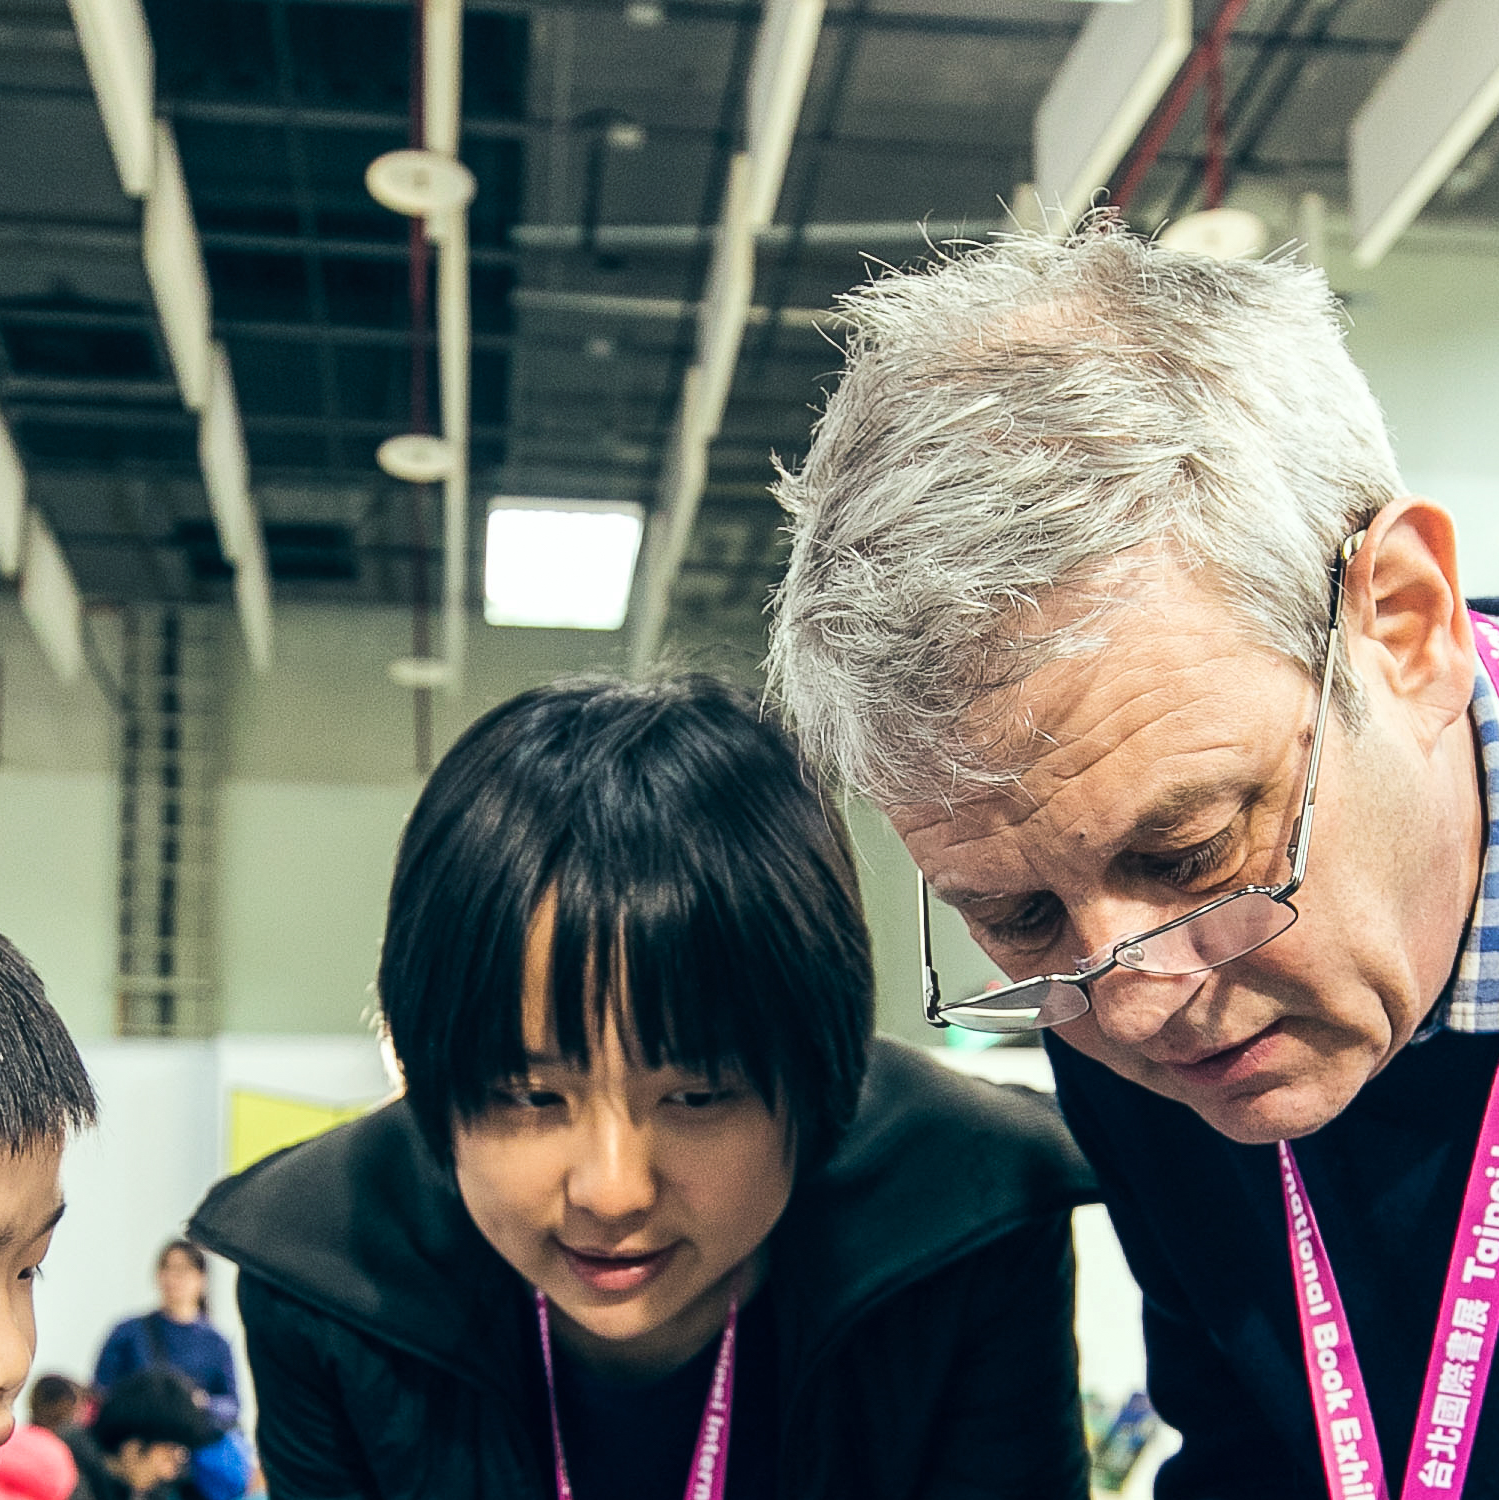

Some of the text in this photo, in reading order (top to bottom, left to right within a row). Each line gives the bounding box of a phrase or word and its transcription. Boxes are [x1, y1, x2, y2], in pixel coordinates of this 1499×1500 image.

[1312, 1321, 1354, 1414] Book
[1418, 1296, 1491, 1490] 台北國際書展
